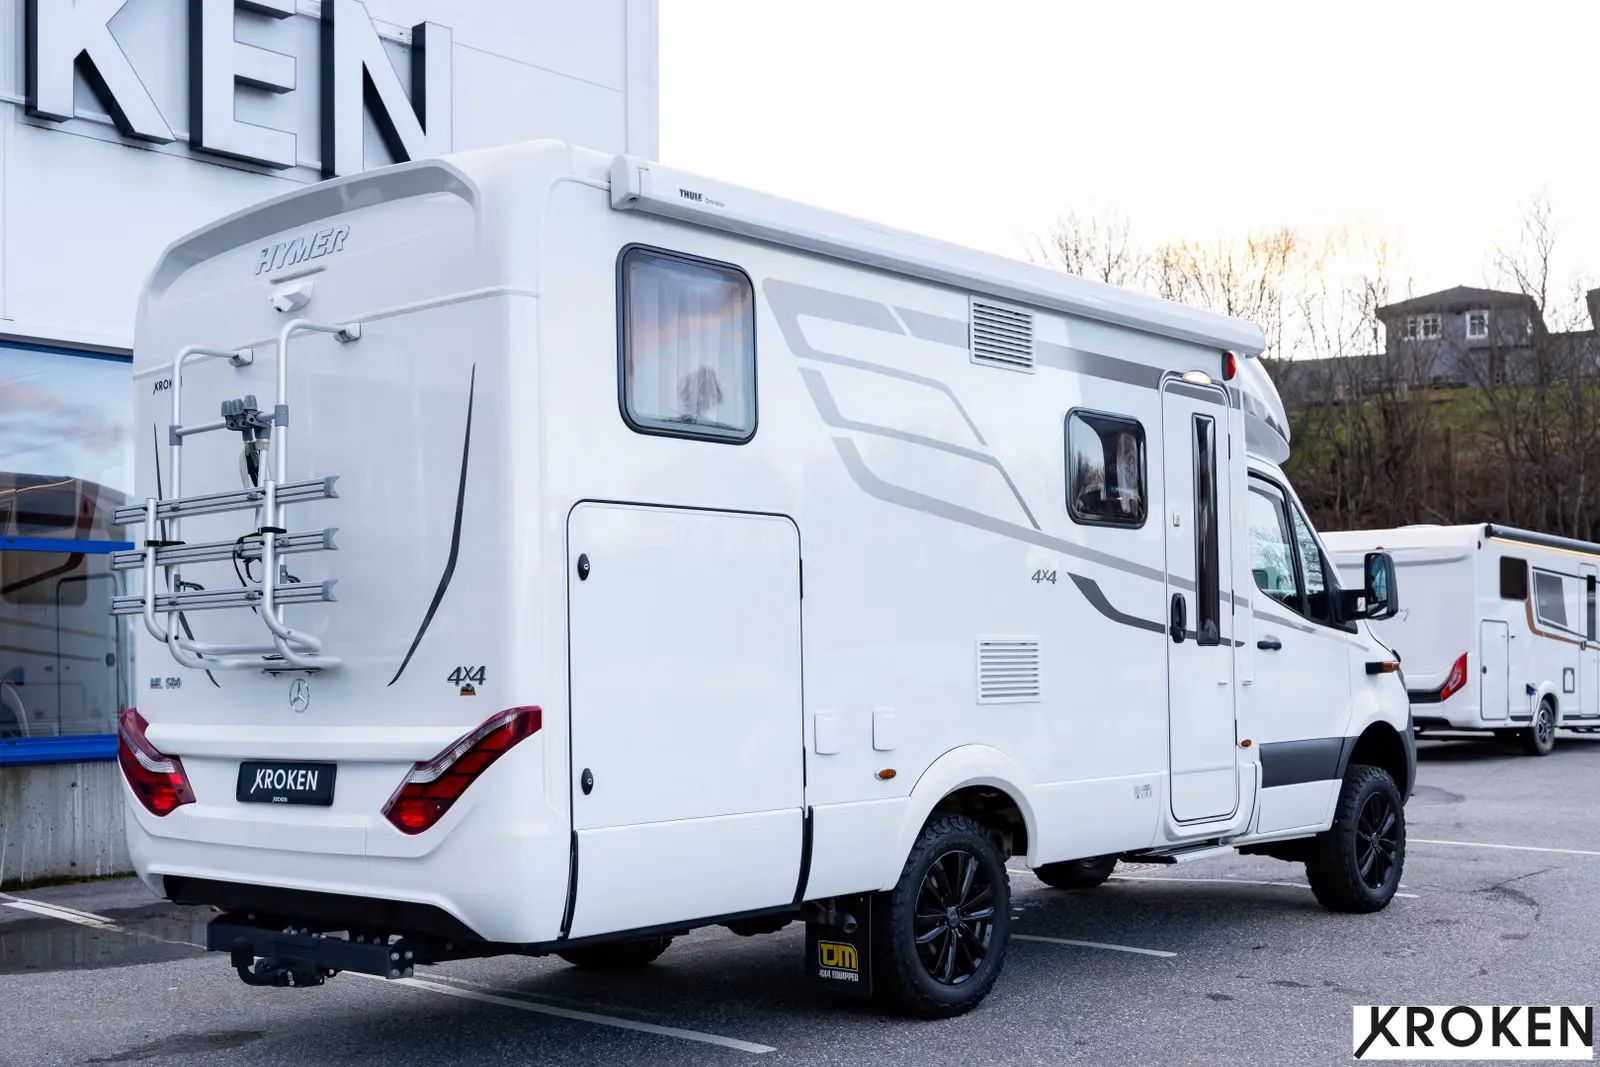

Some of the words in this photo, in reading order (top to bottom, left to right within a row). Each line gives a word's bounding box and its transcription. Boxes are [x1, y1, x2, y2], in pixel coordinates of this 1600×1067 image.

[25, 0, 453, 180] KEN
[679, 188, 703, 203] THULE
[255, 224, 350, 276] HYMER
[250, 768, 319, 794] KROKEN
[831, 970, 859, 982] EQUIPPED
